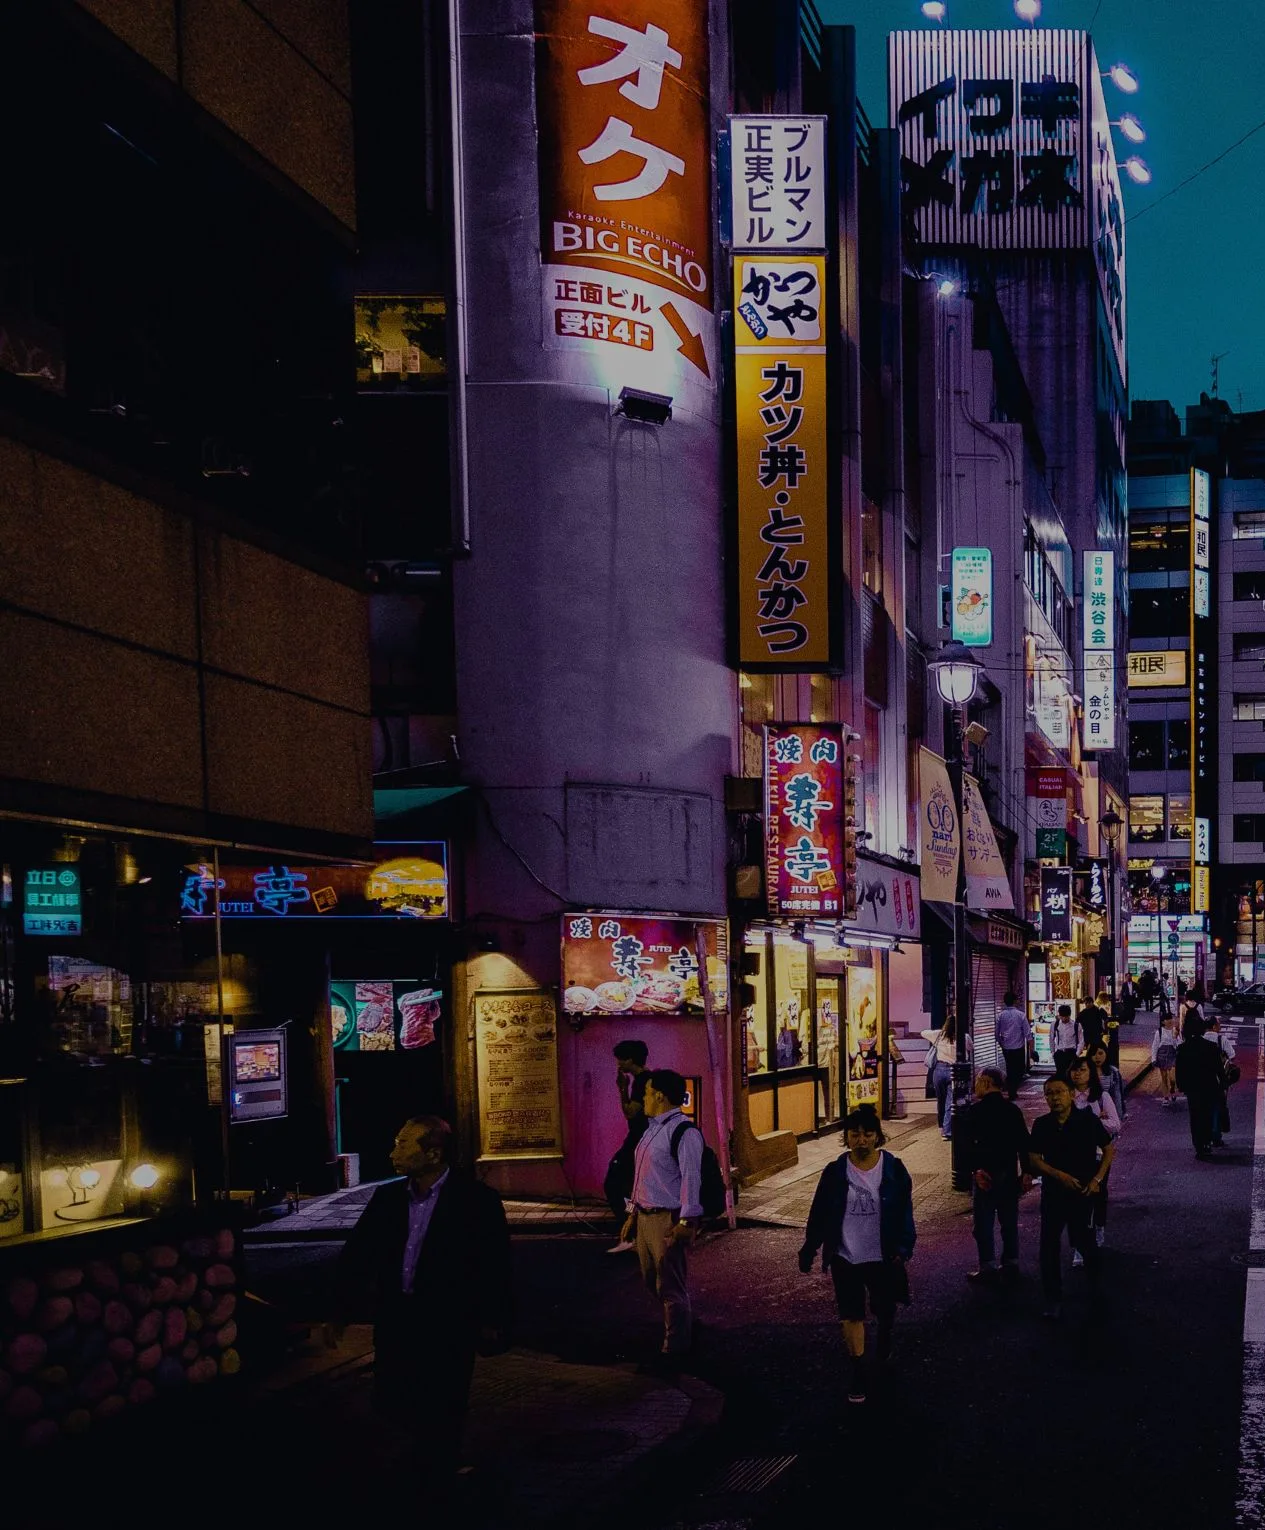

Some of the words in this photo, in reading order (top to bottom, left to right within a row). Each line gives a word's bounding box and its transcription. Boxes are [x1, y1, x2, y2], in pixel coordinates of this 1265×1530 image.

[577, 15, 686, 201] オケ
[744, 124, 774, 244] 正実ビル
[783, 124, 812, 244] ブルマン
[553, 221, 620, 252] BIG
[627, 236, 707, 292] ECHO
[568, 210, 615, 226] Karaoke
[620, 220, 696, 258] Entertainment
[555, 279, 652, 314] 正面ビル
[741, 267, 817, 337] かつや
[561, 312, 649, 347] 受付4F
[757, 360, 809, 654] カツ丼・とんかつ
[1090, 592, 1107, 645] 渋谷会
[1130, 656, 1165, 675] 和民
[1089, 695, 1102, 734] 金の目
[775, 734, 837, 763] 焼肉
[767, 815, 780, 914] RESTAURANT
[570, 917, 621, 938] 焼肉
